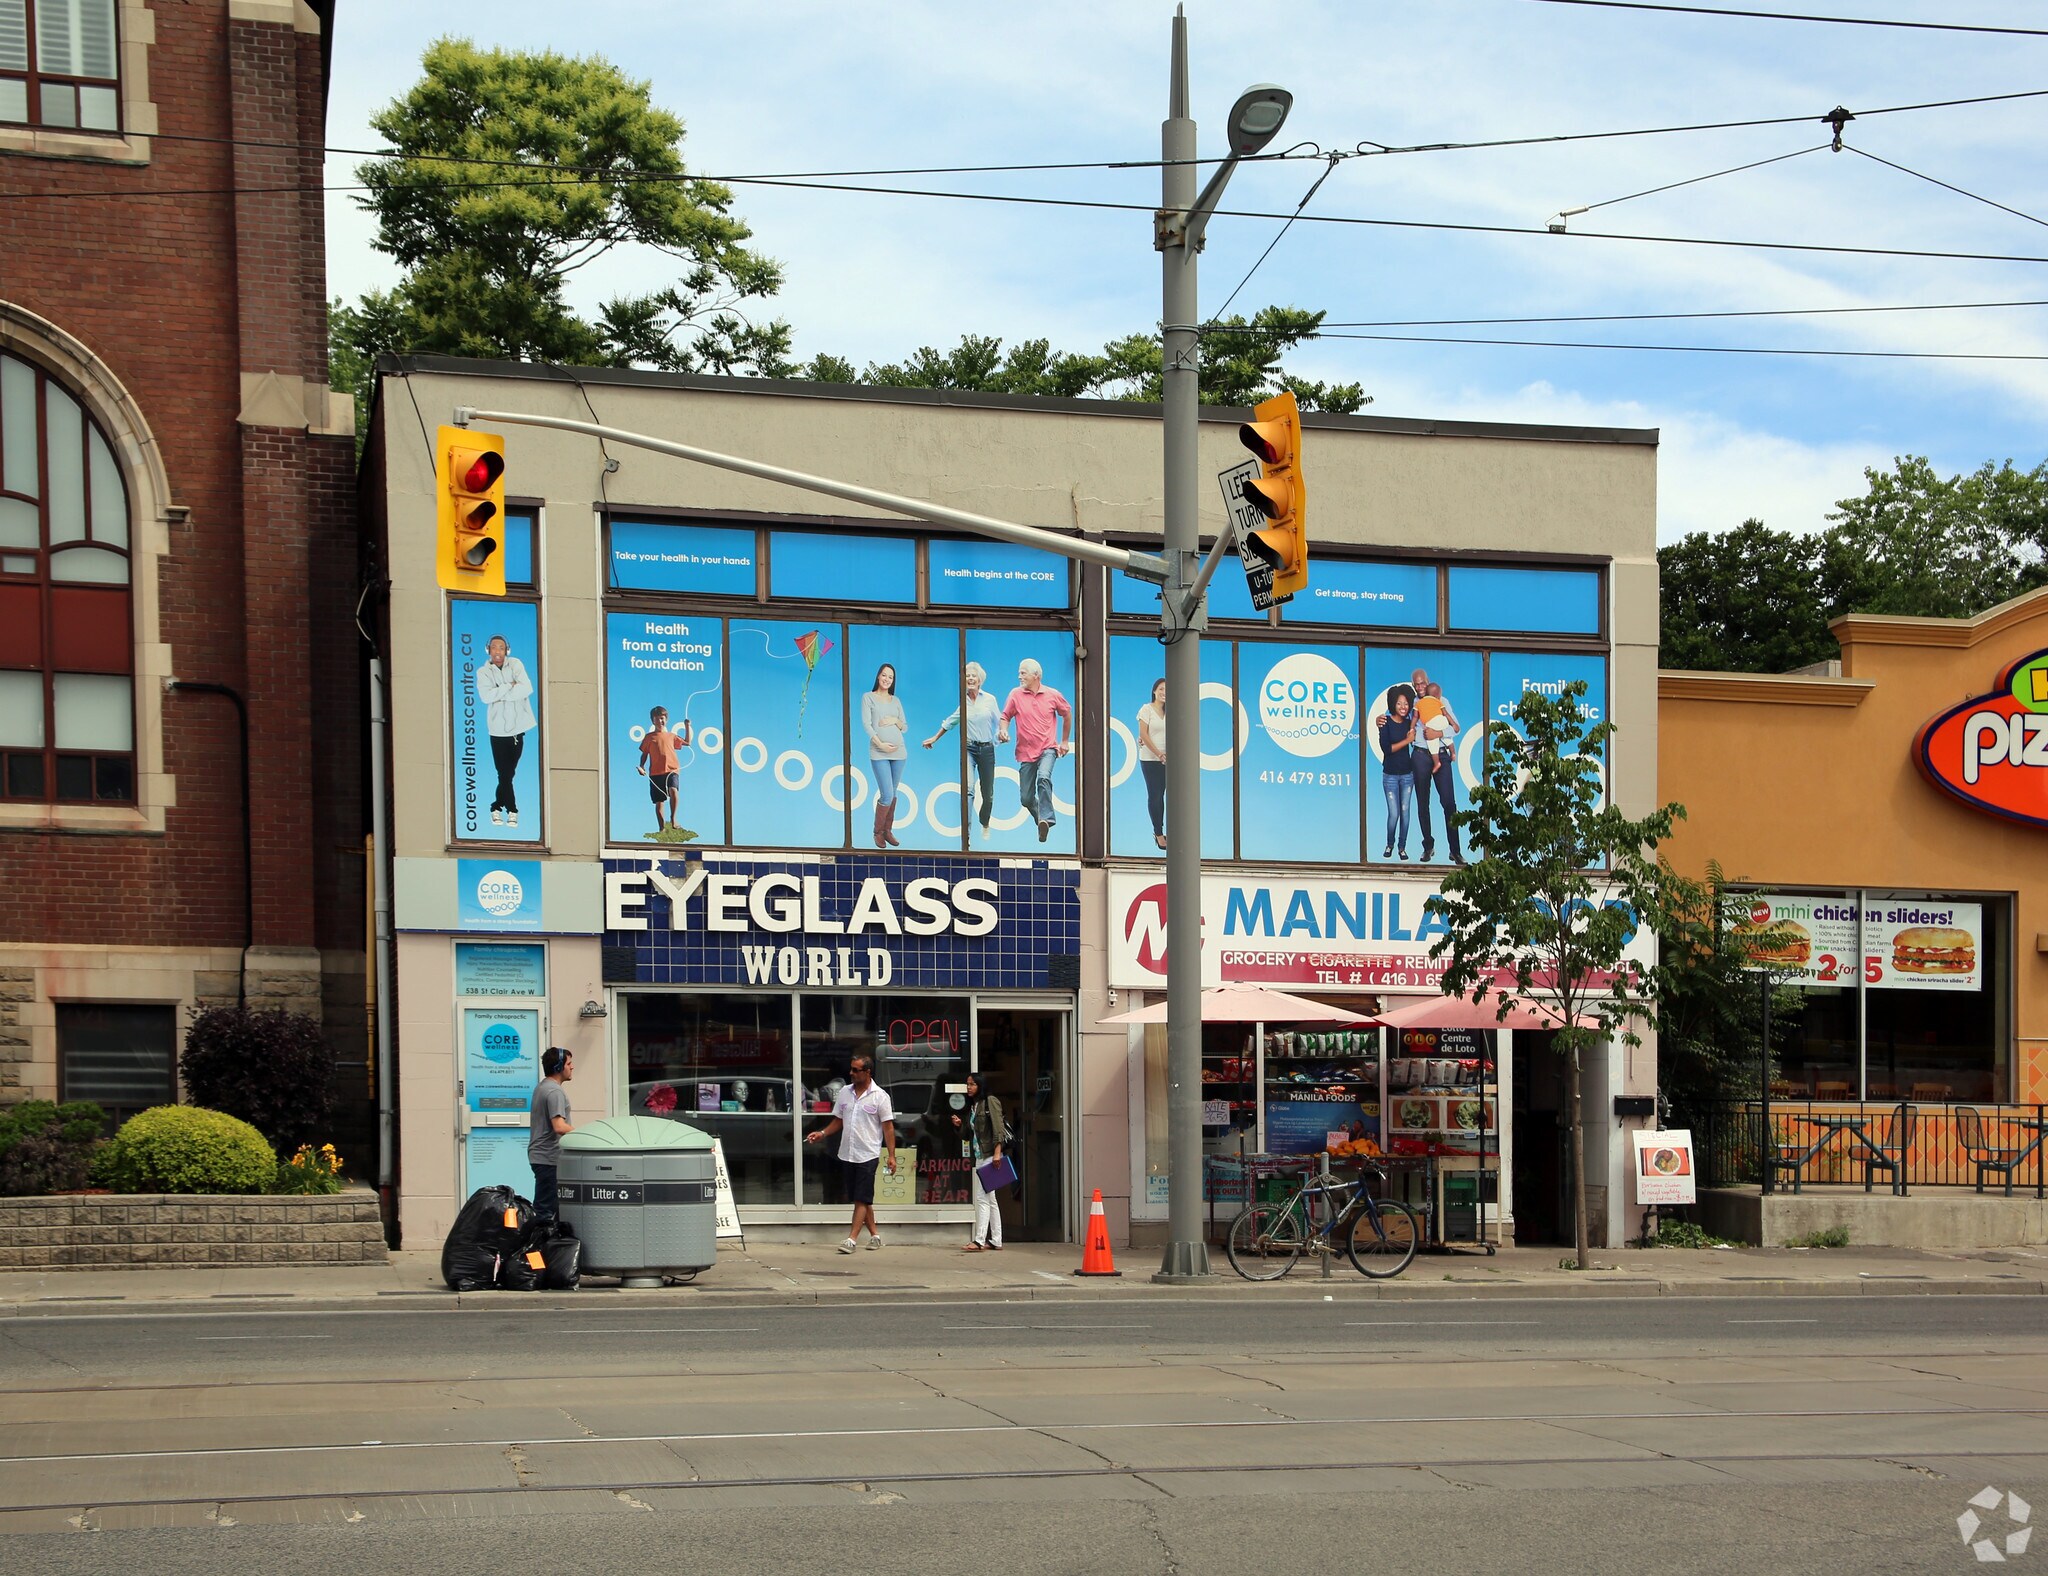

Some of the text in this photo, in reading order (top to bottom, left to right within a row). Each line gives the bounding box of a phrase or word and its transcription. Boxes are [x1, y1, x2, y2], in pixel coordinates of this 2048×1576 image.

[1235, 504, 1265, 530] TURN
[615, 551, 751, 566] Take your health in your hands
[944, 568, 1055, 581] Health begins at the CORE
[1315, 588, 1404, 602] Get strong, stay strong
[645, 622, 689, 636] Health
[622, 638, 712, 656] from a strong
[630, 656, 704, 671] foundation
[1265, 679, 1347, 704] CORE
[1522, 678, 1574, 696] Famil
[1266, 705, 1346, 720] wellness
[461, 633, 477, 832] corewellnesscentre.ca
[1260, 770, 1350, 786] 416 479 8311
[480, 883, 519, 894] CORE
[606, 868, 998, 937] EYEGLASS
[1223, 887, 1455, 942] MANILA
[1752, 908, 1769, 918] NEW
[1775, 903, 1810, 919] mini
[1887, 908, 1954, 925] sliders!
[742, 944, 893, 987] WORLD
[1223, 951, 1296, 966] GROCERY
[1309, 953, 1392, 968] CIGARETTE
[1817, 954, 1883, 983] 2 for 5
[1316, 971, 1343, 984] TEL
[1349, 972, 1362, 984] #
[1381, 972, 1407, 985] 416
[465, 987, 479, 995] 538
[481, 987, 488, 995] St
[484, 1035, 519, 1044] CORE
[889, 1019, 958, 1052] OPEN
[1441, 1034, 1472, 1043] Centre
[1441, 1043, 1476, 1053] de Loto
[1038, 1079, 1051, 1090] OPEN
[1290, 1093, 1356, 1102] MANILA FOODS
[1205, 1102, 1228, 1112] RATE
[913, 1158, 972, 1173] PARKING
[932, 1174, 950, 1188] AT
[562, 1186, 575, 1198] Litter
[592, 1187, 616, 1200] Litter
[921, 1189, 969, 1203] REAR
